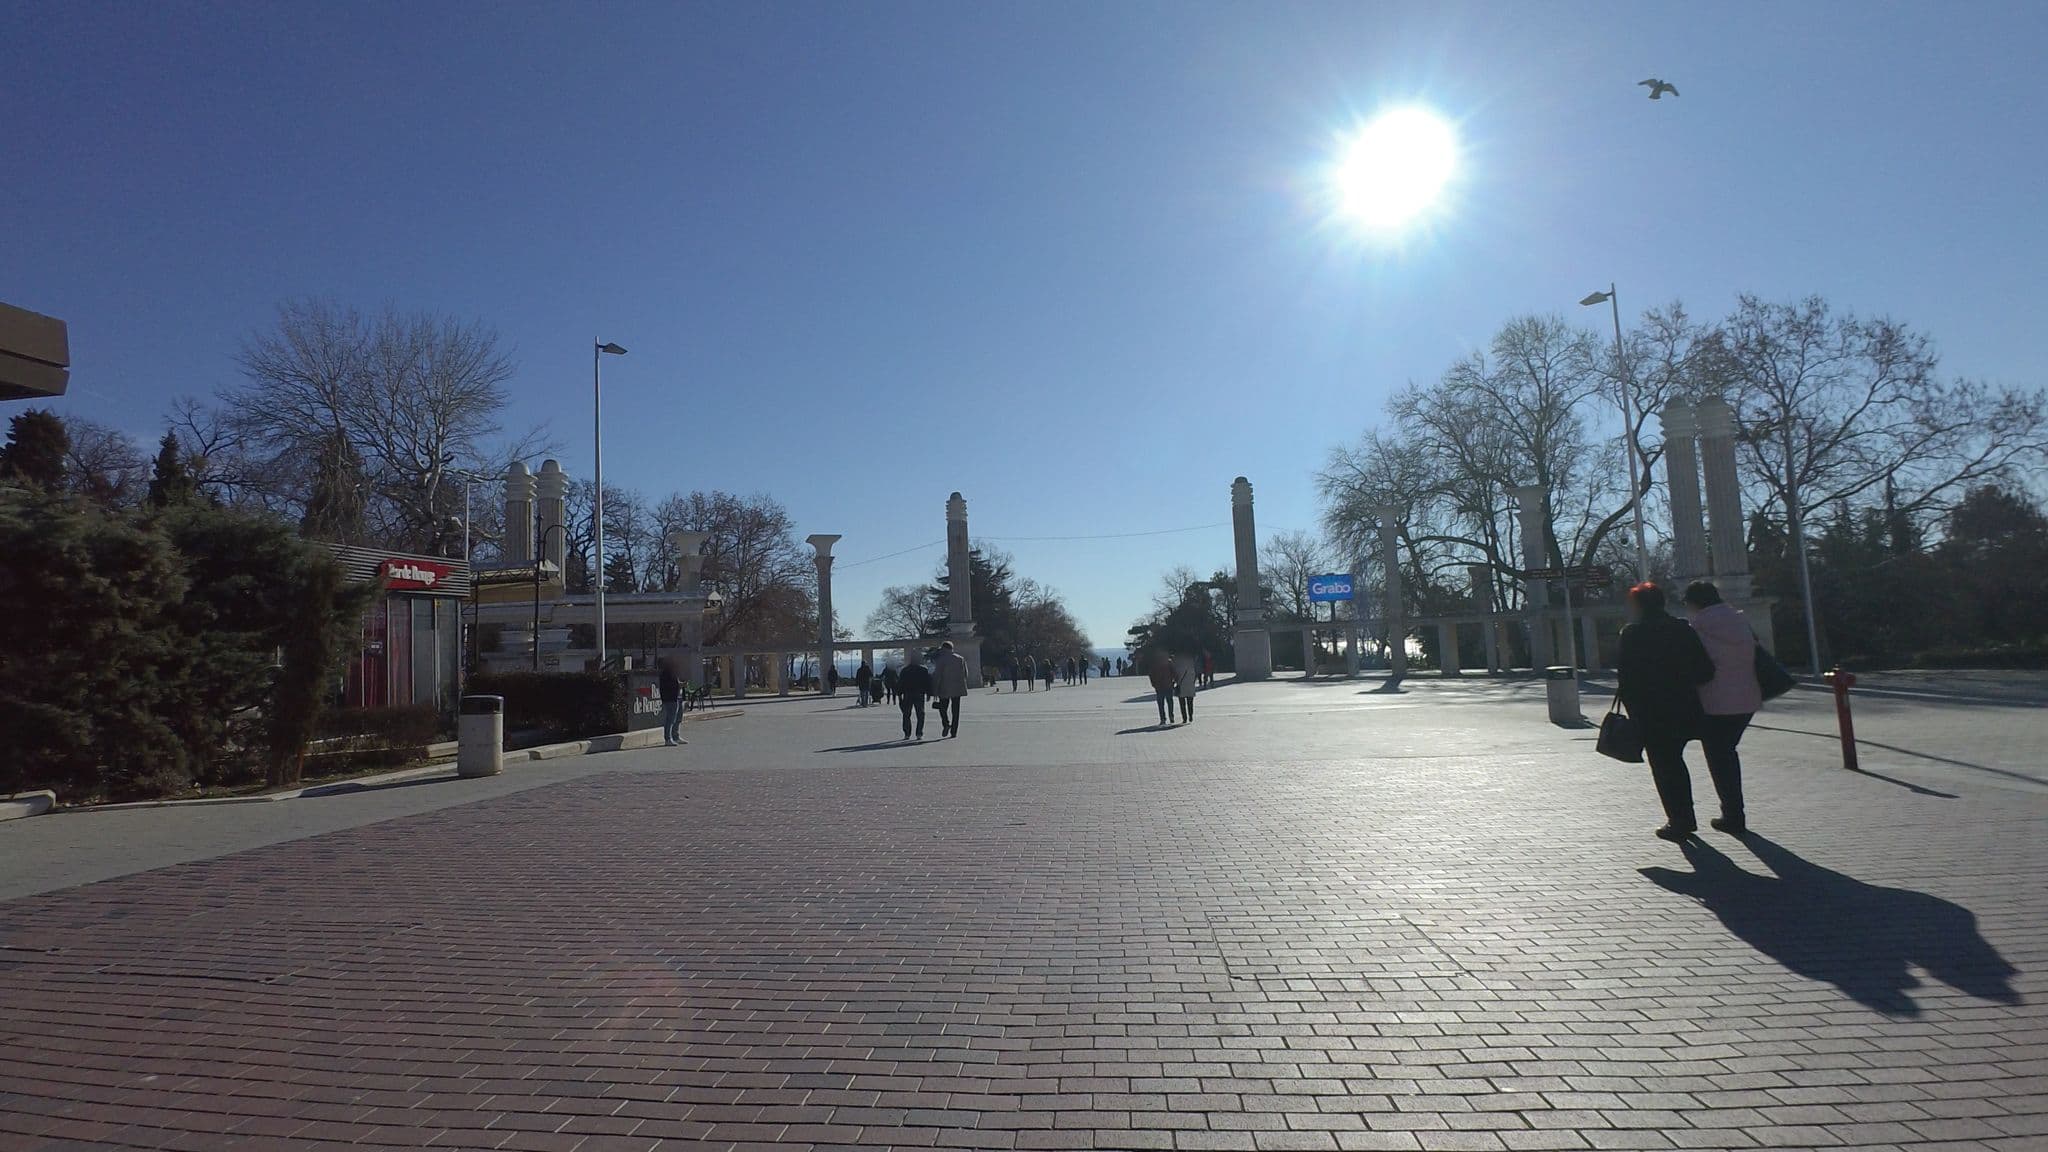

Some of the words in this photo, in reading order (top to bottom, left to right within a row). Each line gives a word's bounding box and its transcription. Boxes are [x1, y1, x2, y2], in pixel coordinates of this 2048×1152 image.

[1312, 582, 1351, 595] Grabo
[634, 697, 643, 714] de
[643, 696, 663, 716] Rouge
